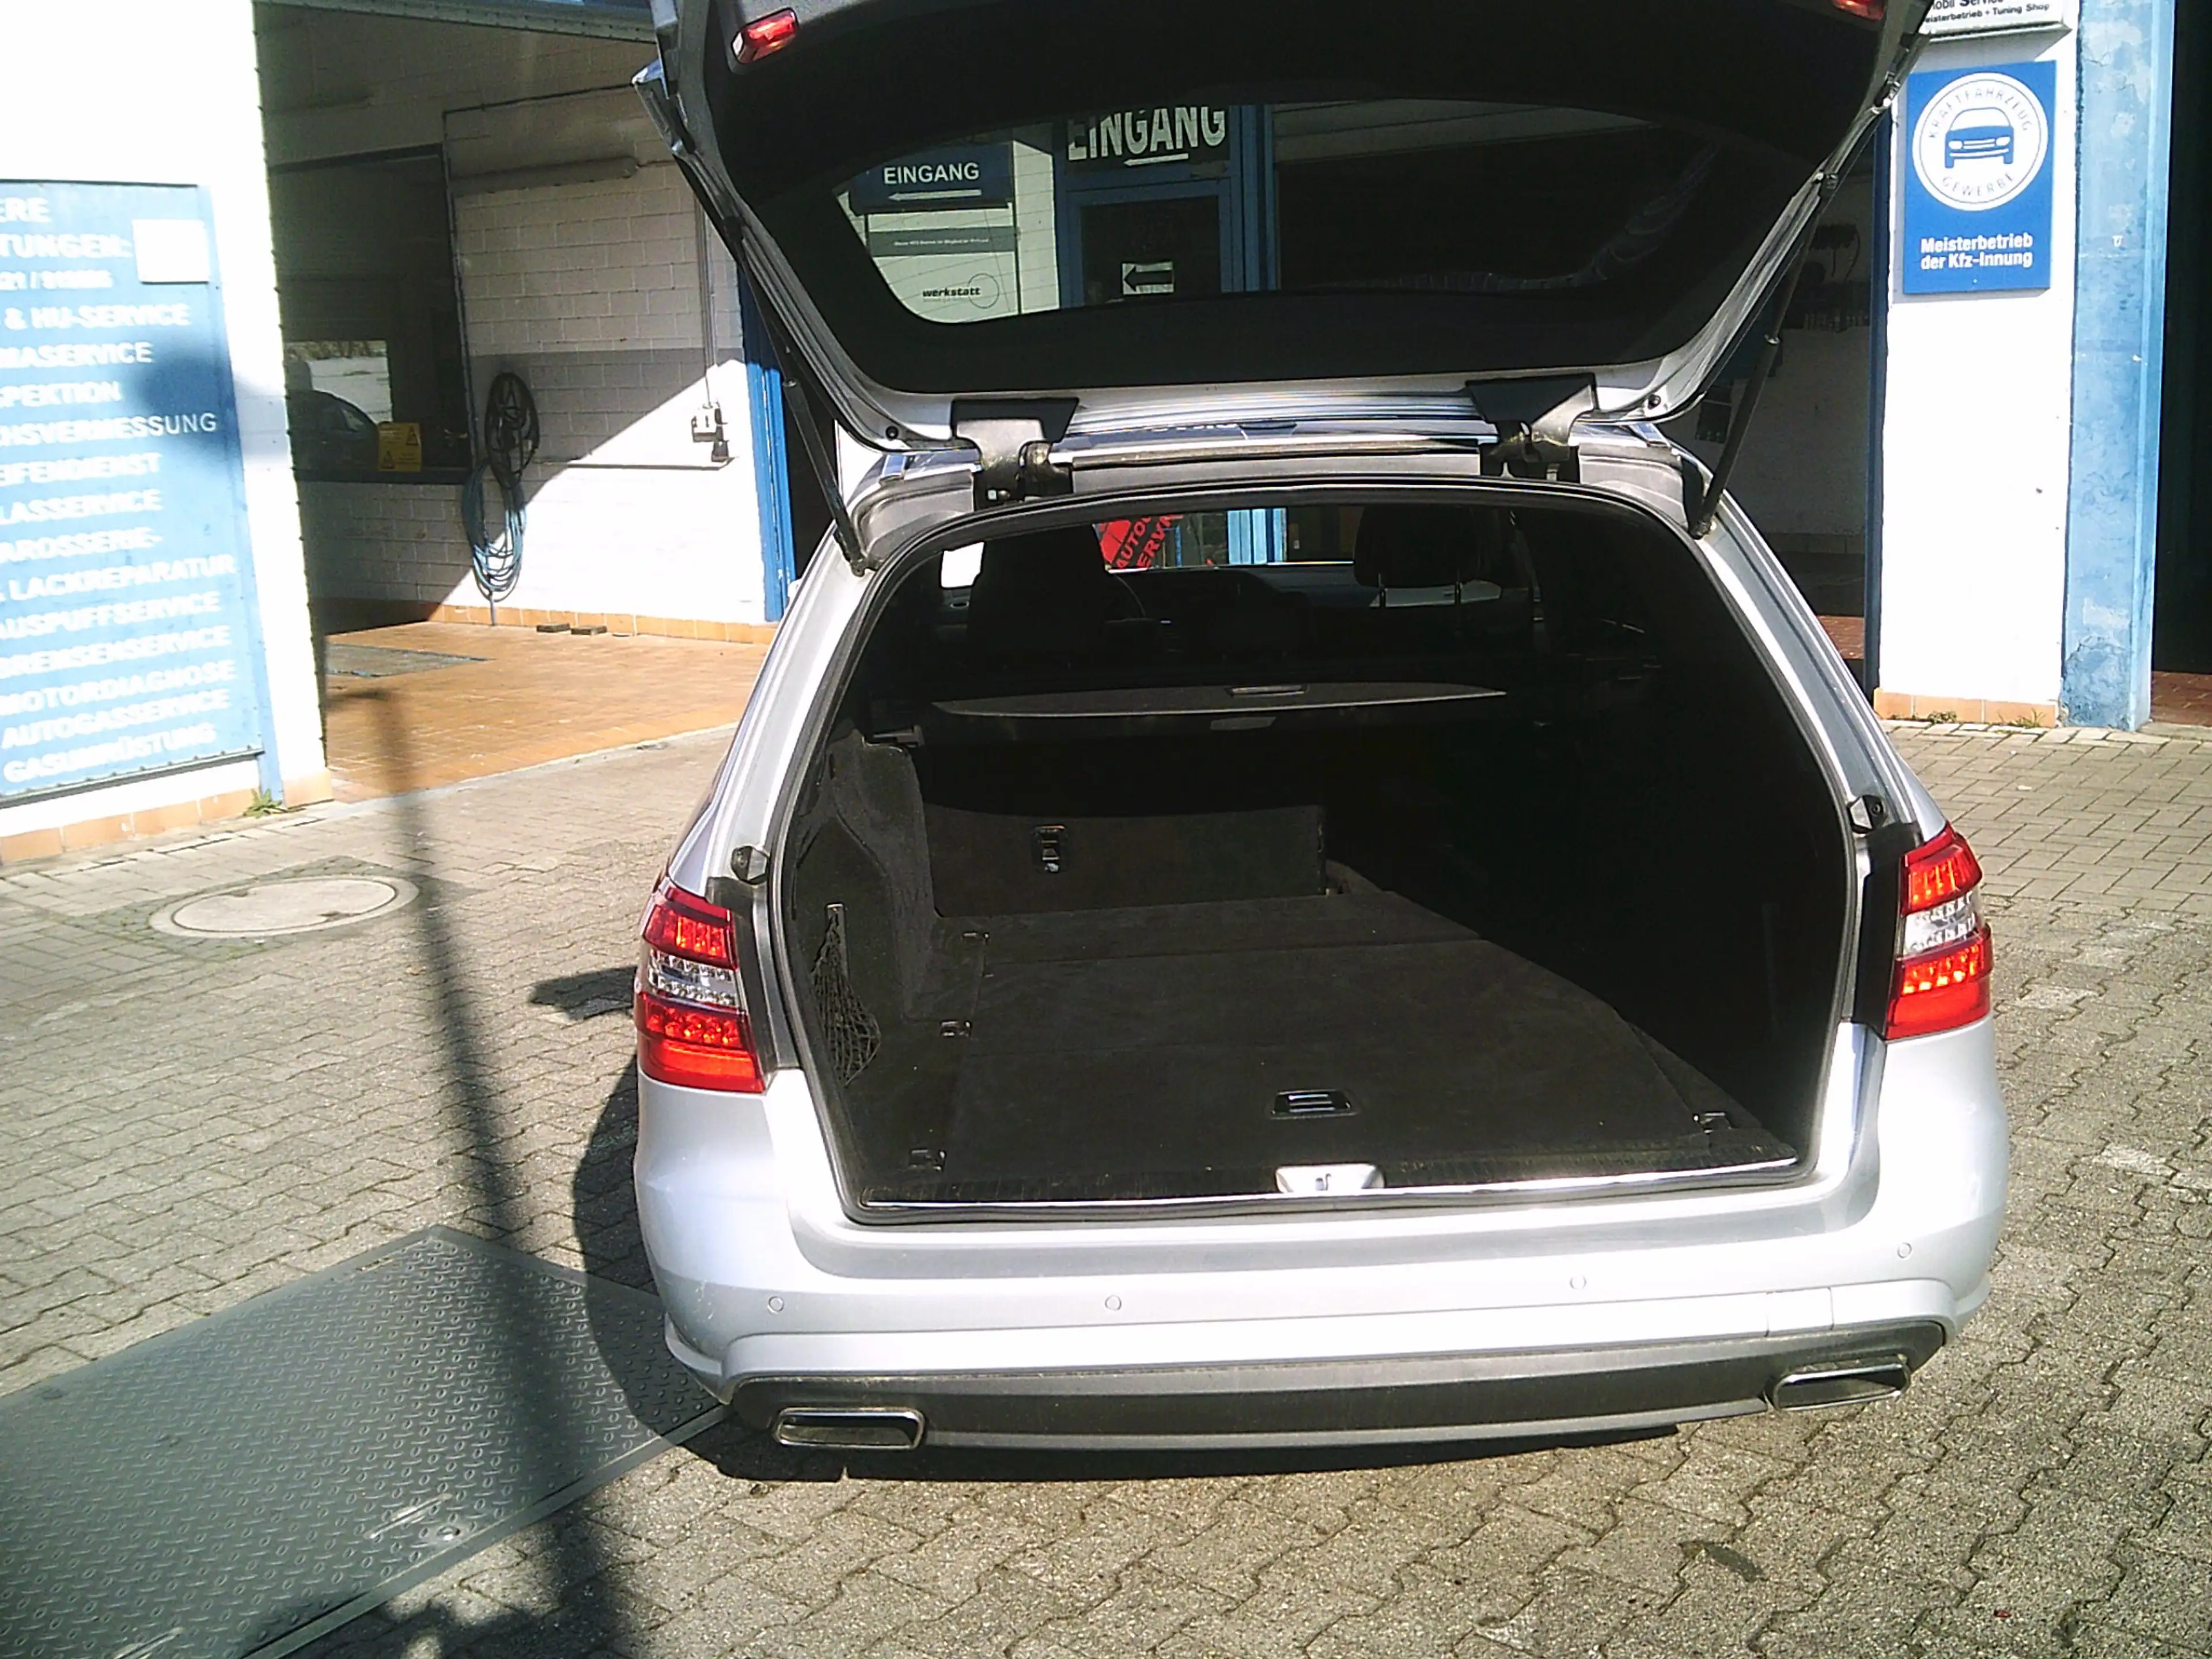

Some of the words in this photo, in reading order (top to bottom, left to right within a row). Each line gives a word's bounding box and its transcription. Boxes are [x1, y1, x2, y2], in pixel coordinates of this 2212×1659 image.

[1993, 5, 2022, 16] Tuning
[2025, 3, 2050, 12] Shop
[1929, 87, 2033, 139] KRAFTFAHRZEUG
[1067, 105, 1226, 161] EINGANG
[883, 162, 980, 185] EINGANG
[1942, 172, 2015, 197] GEWERBE
[1920, 232, 2034, 253] Meisterbetrieb
[1920, 255, 1946, 270] der
[1948, 251, 2033, 268] Kfz-Innung
[922, 287, 981, 298] werkstatt
[4, 308, 26, 330] &
[31, 303, 191, 329] HU-SERVICE
[9, 554, 236, 601] LACKREPARATUR
[2, 688, 231, 749] AUTOGASSERVICE
